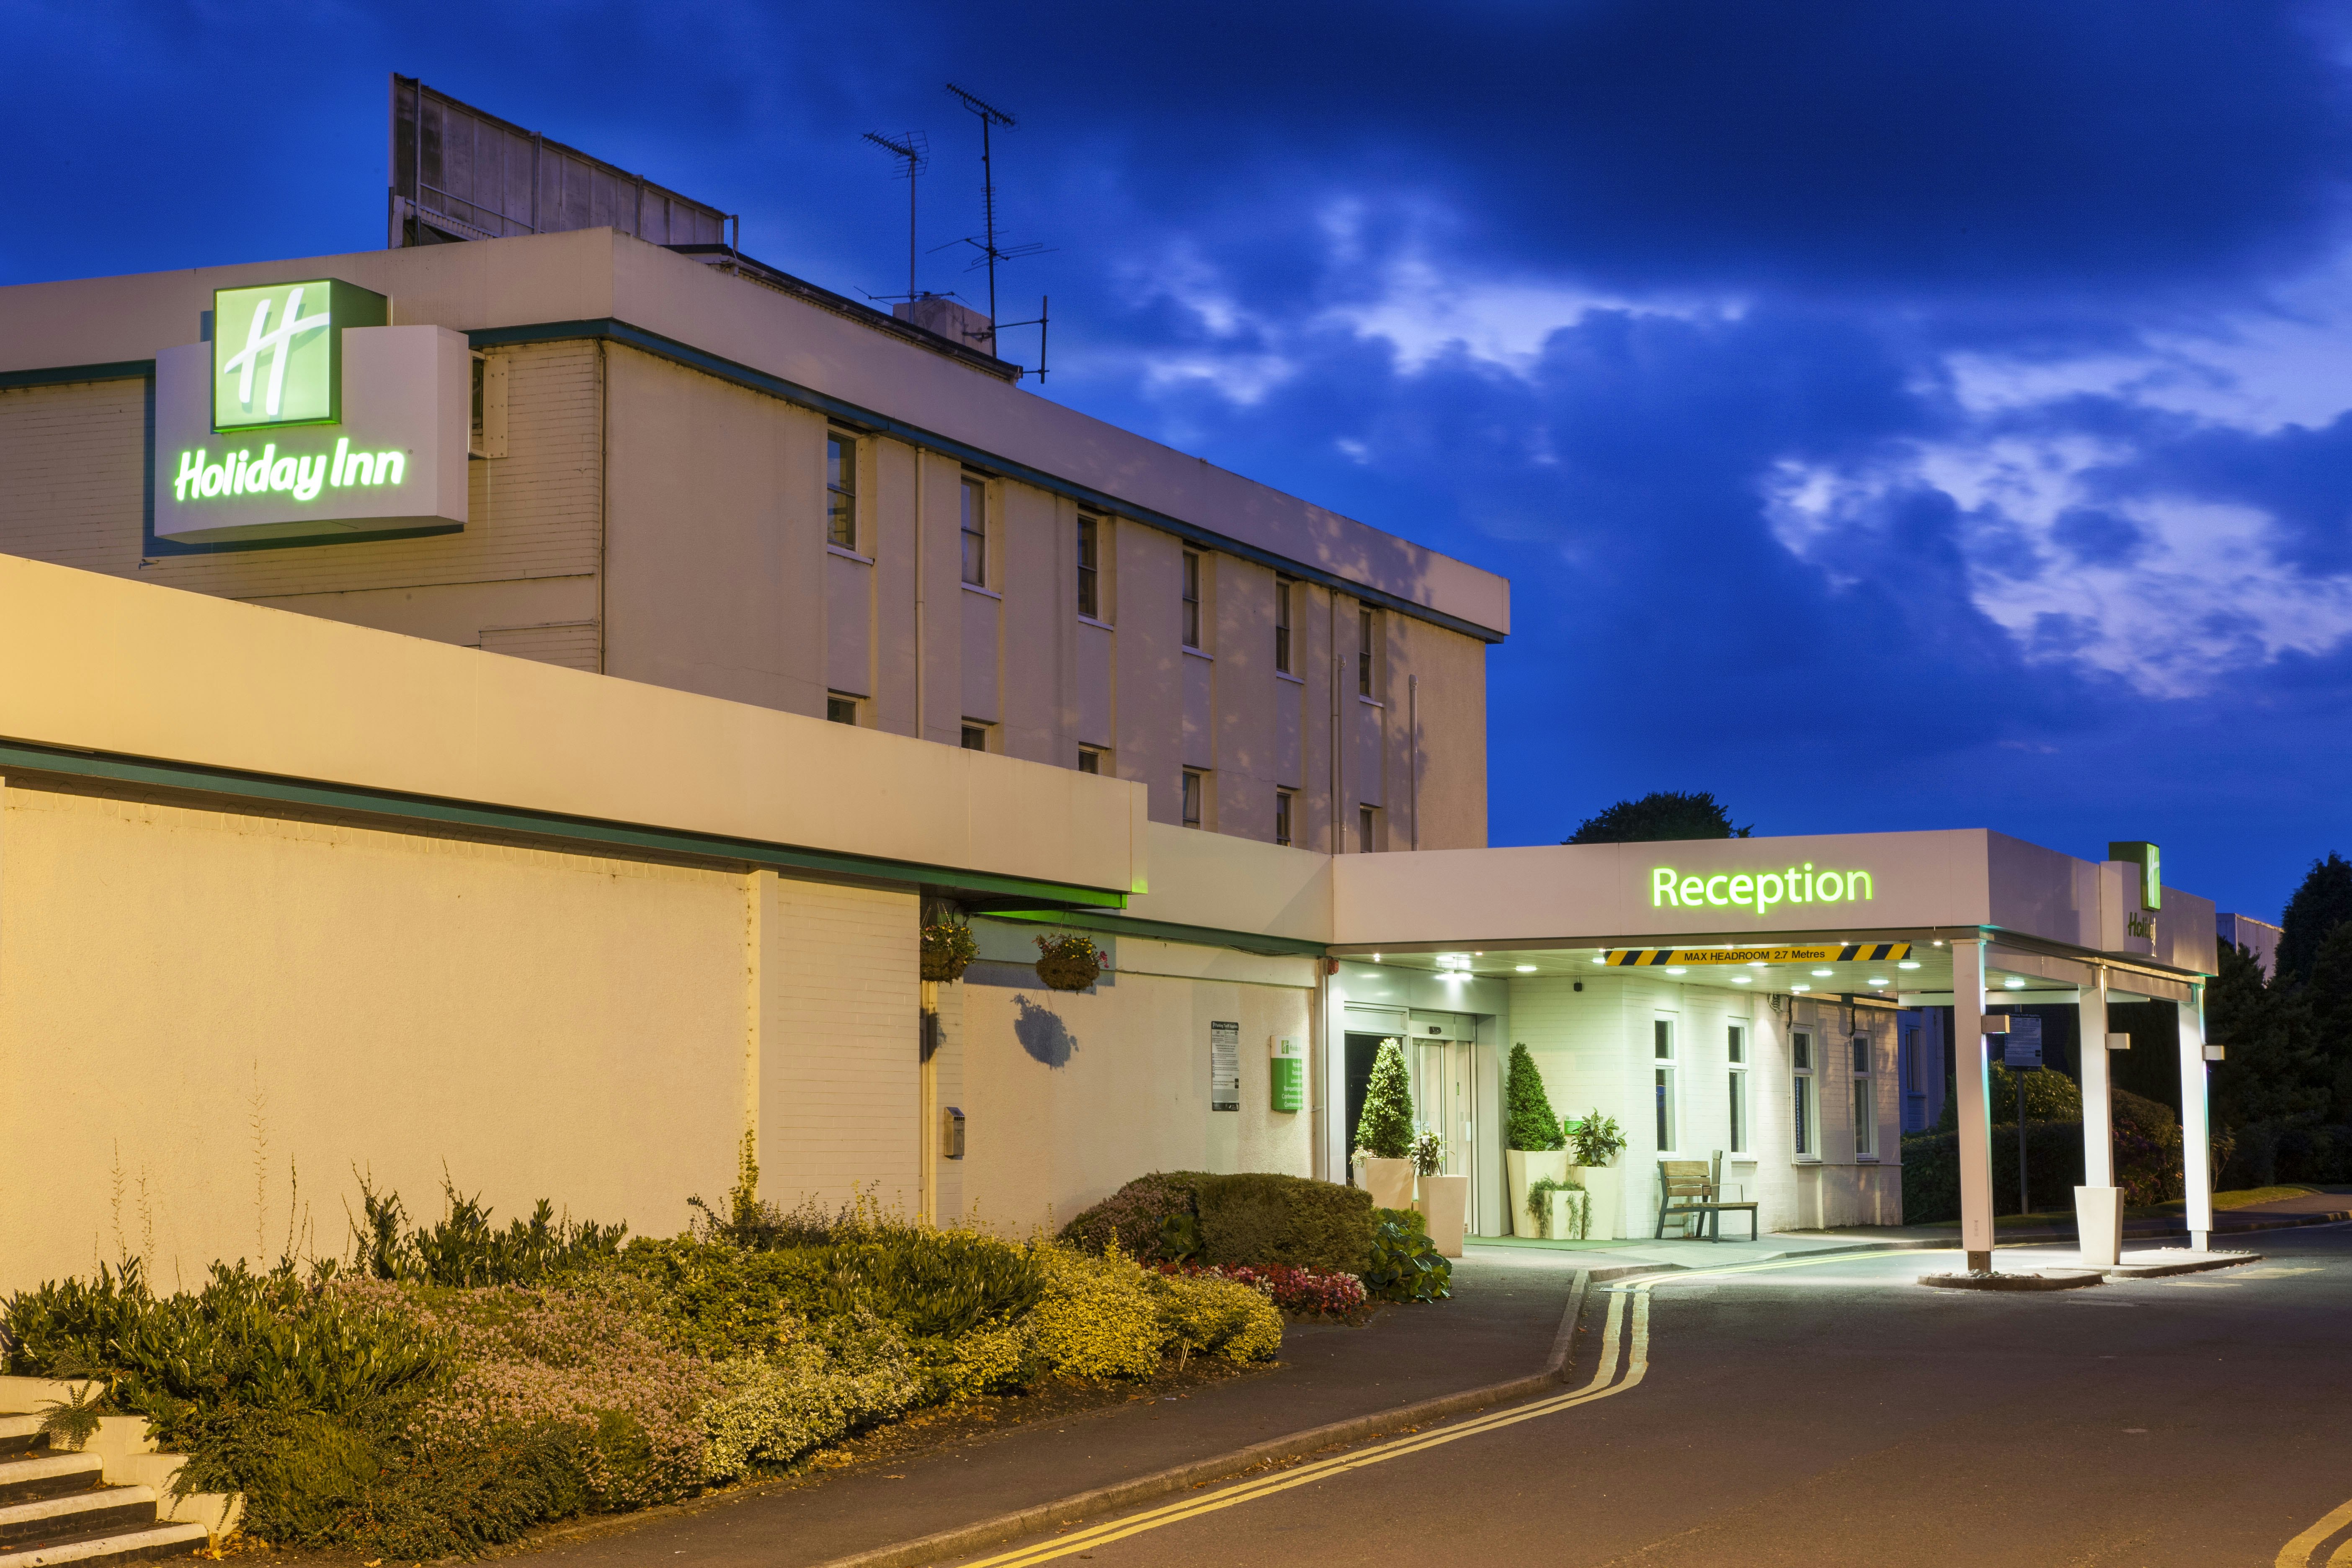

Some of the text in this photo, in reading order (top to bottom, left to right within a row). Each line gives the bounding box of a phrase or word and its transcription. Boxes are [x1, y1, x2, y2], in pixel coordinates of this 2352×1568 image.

[174, 437, 405, 501] Holiday Inn
[1653, 863, 1872, 914] Reception
[1684, 950, 1825, 961] MAX HEADROOM 2.7 Metres
